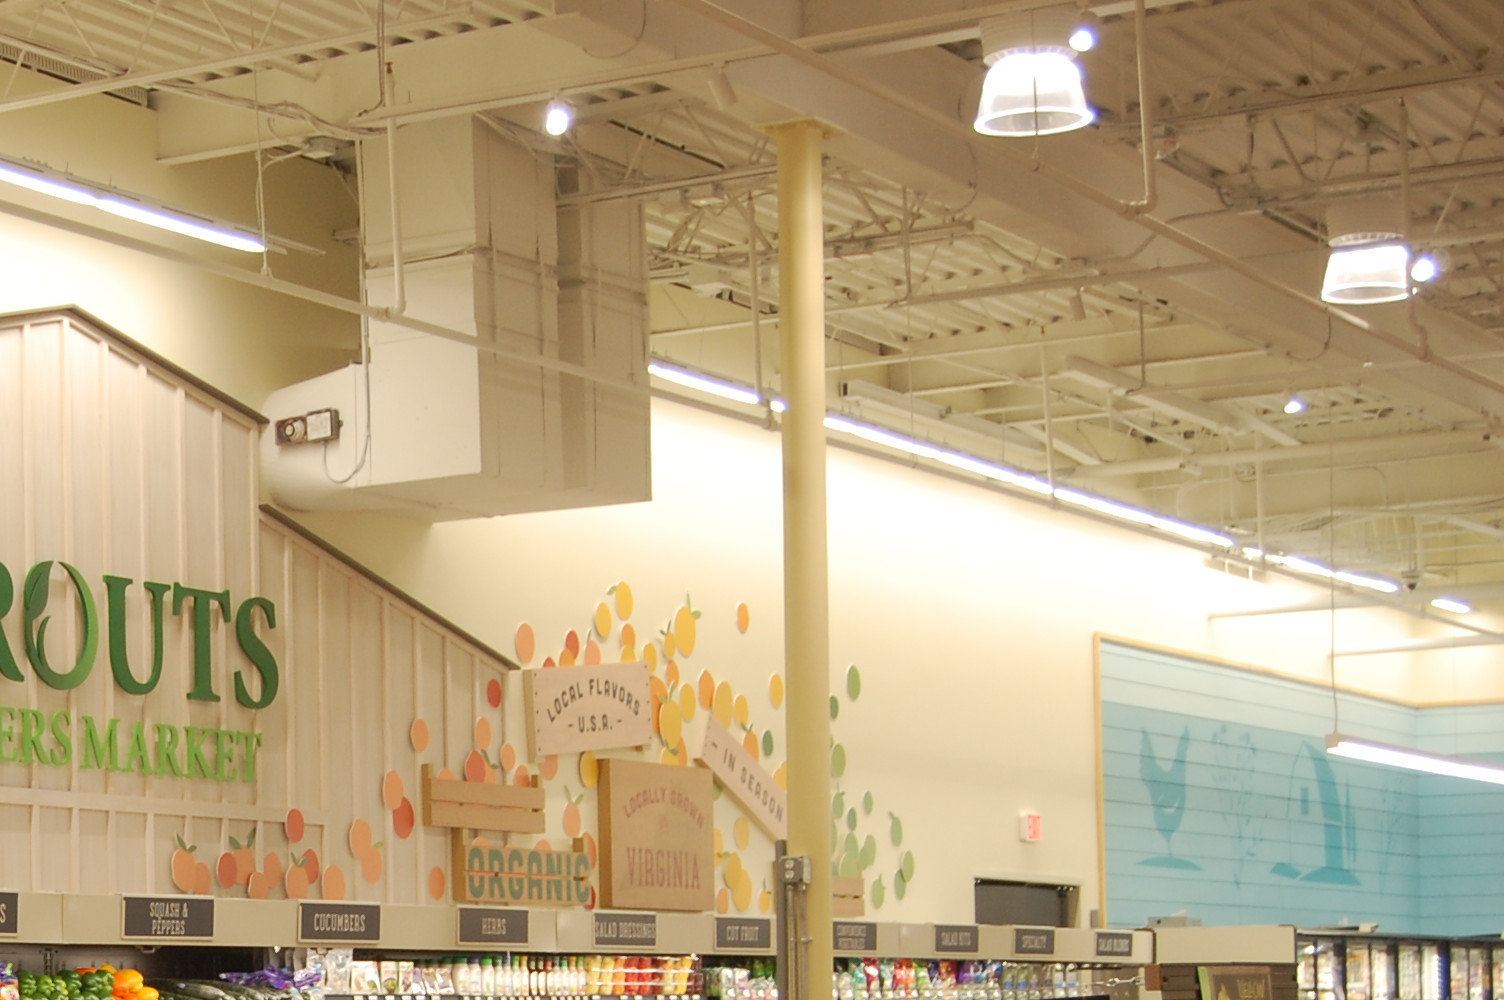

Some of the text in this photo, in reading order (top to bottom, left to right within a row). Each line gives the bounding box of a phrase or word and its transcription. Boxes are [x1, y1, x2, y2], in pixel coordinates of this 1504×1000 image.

[547, 678, 640, 723] LOCAL FLAVORS
[578, 714, 613, 733] U.S.A.
[81, 715, 262, 783] MARKET
[723, 748, 783, 823] IN SEASON
[624, 787, 666, 819] LOCALLY
[670, 790, 704, 829] GROWN
[467, 846, 591, 902] ORGANIC
[626, 847, 700, 889] VIRGINIA
[149, 902, 188, 918] SQUASH &
[152, 919, 185, 935] PEPPERS
[314, 913, 366, 933] CUCUMBERS
